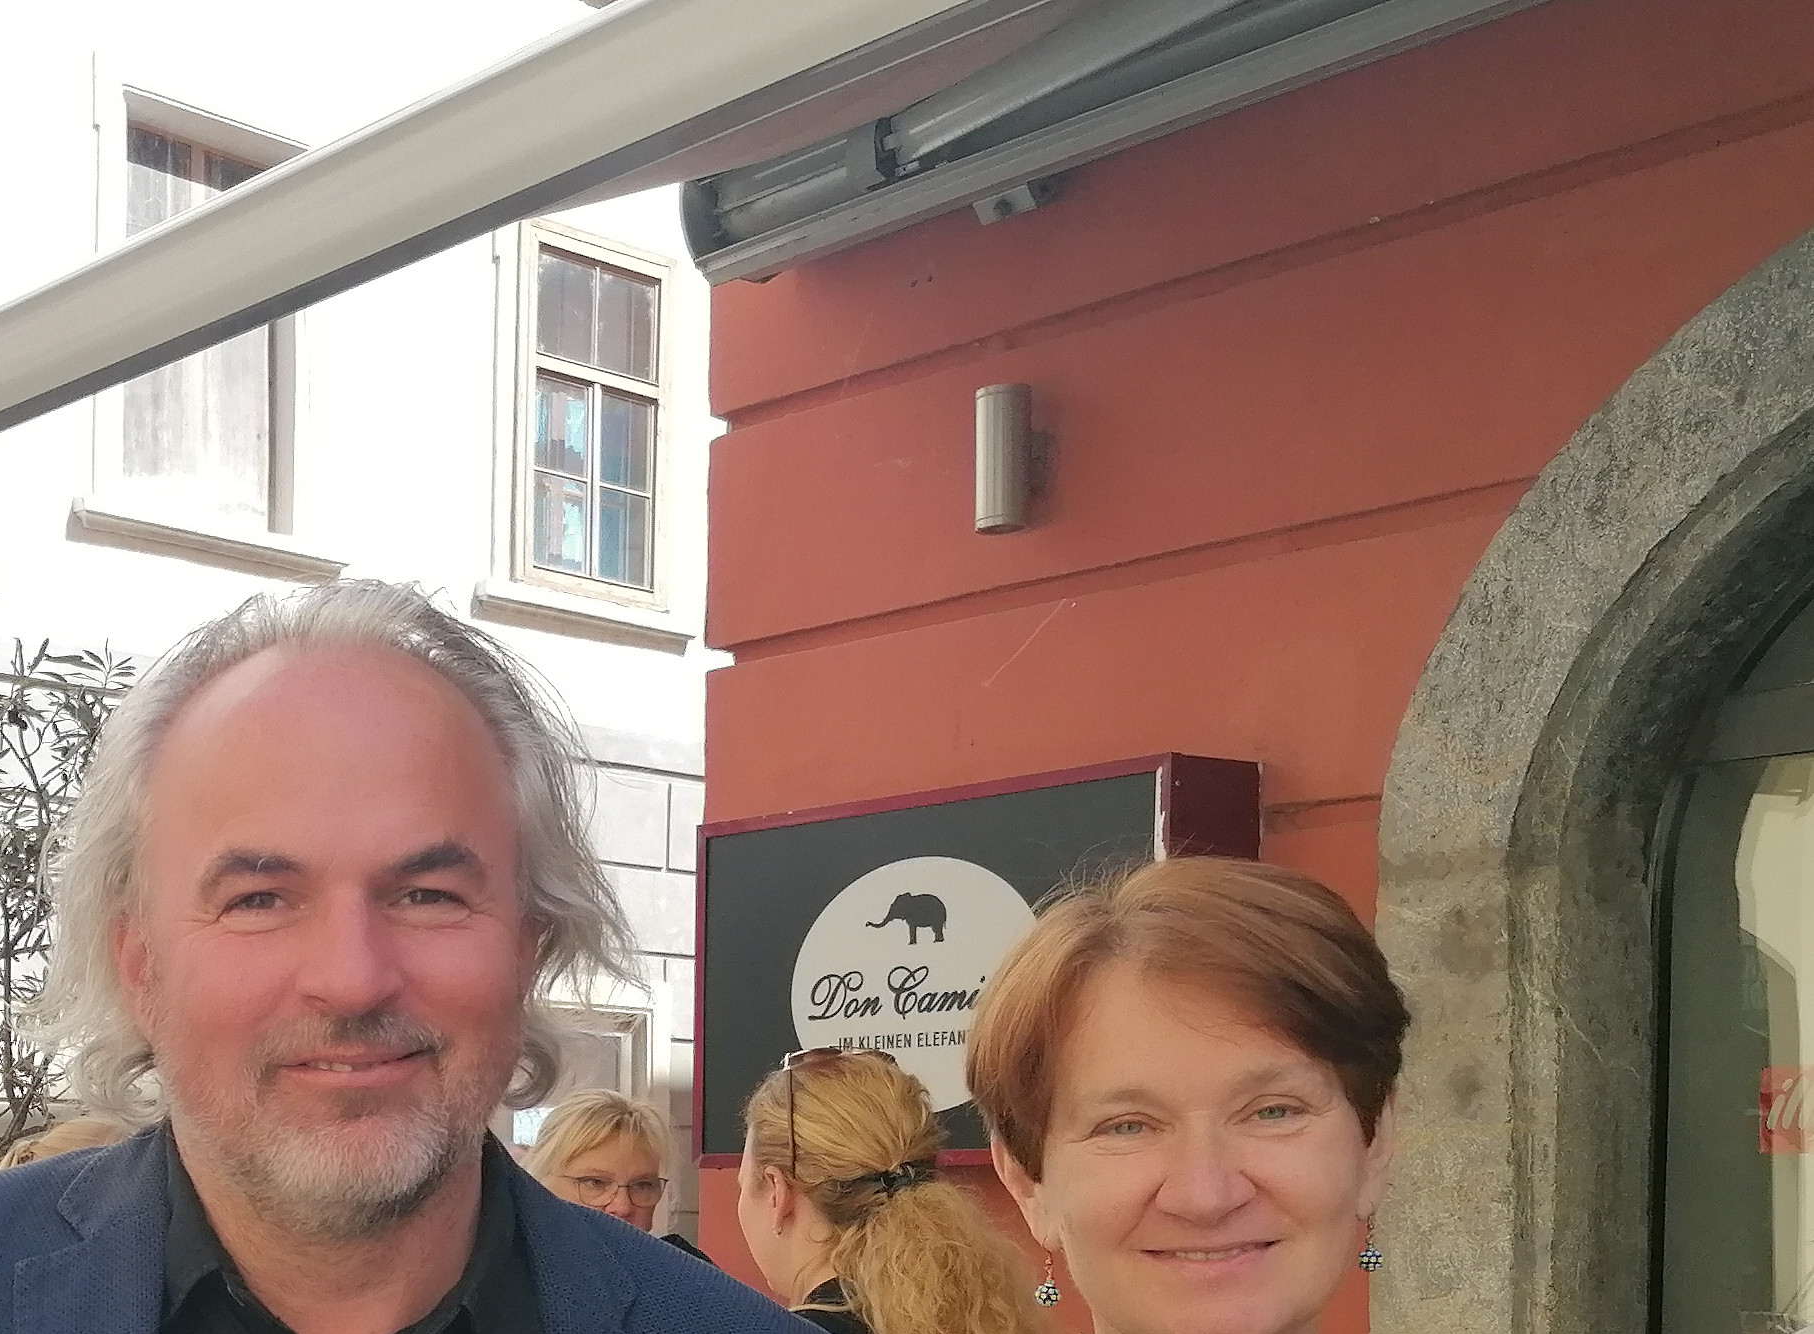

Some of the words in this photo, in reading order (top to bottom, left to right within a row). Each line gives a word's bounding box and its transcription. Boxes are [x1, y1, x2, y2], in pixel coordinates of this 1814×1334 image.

[808, 970, 883, 1021] Don
[887, 965, 987, 1020] Cami
[838, 1037, 853, 1051] IM
[858, 1033, 912, 1050] KLEINEN
[917, 1029, 967, 1047] ELEFAN
